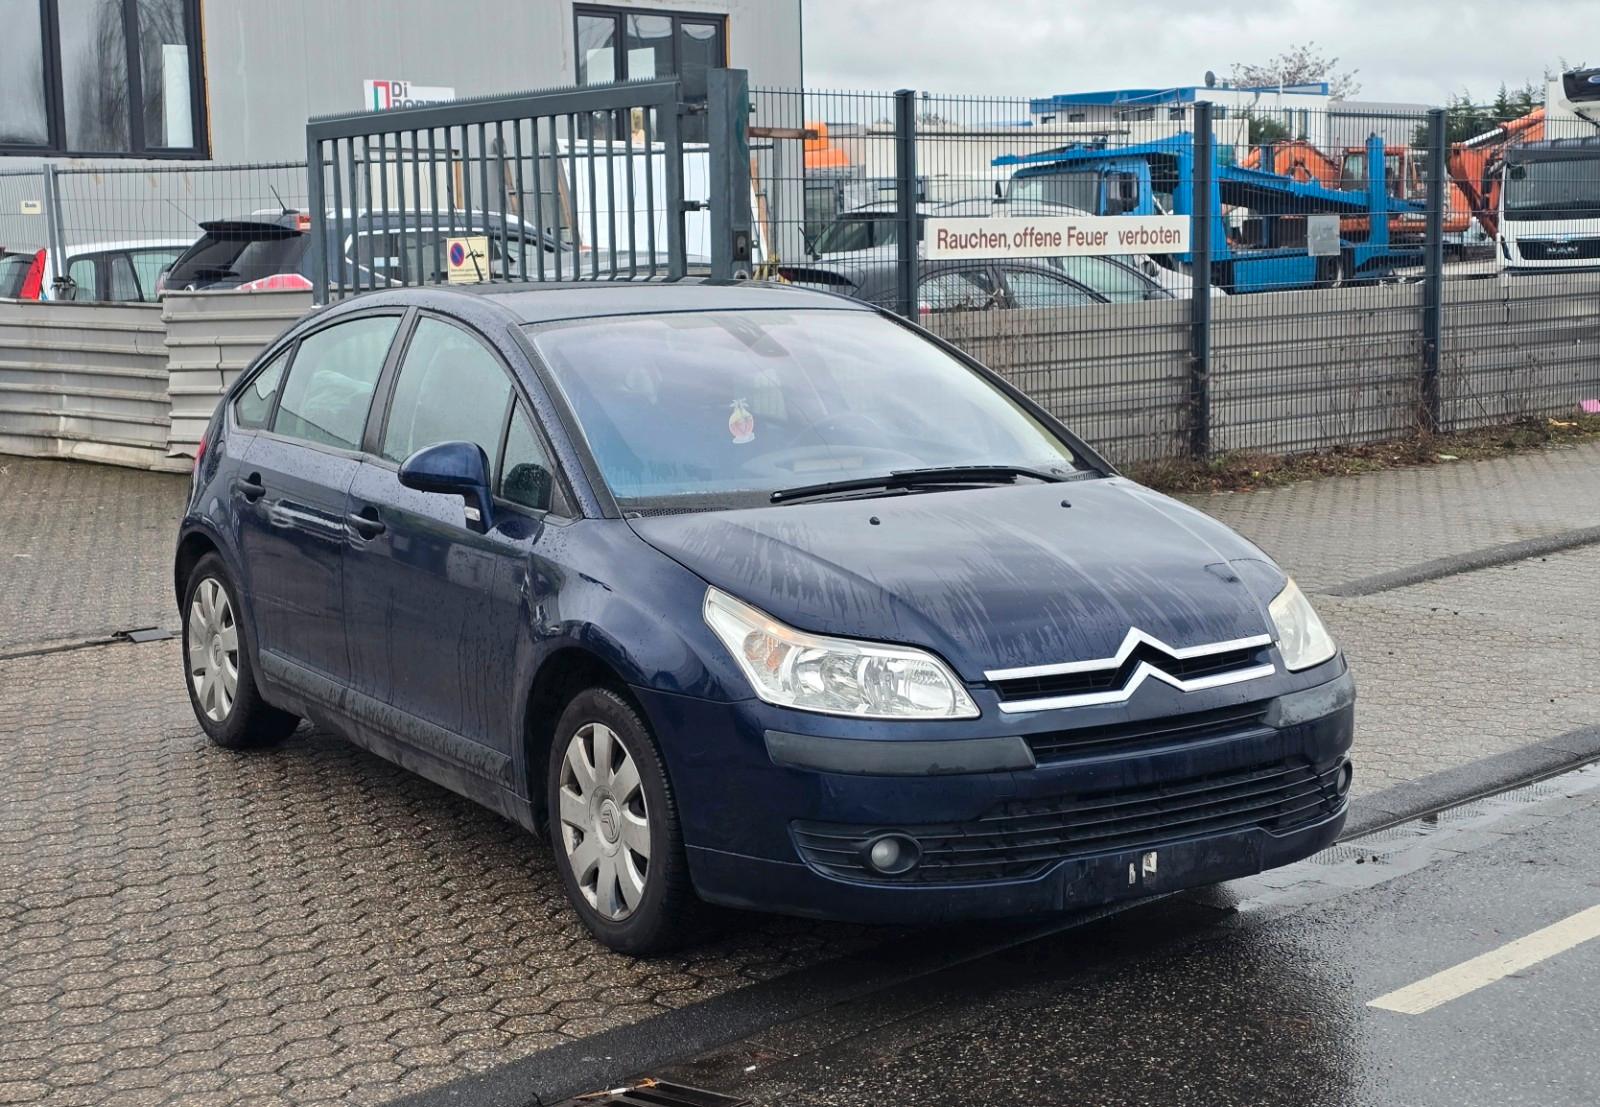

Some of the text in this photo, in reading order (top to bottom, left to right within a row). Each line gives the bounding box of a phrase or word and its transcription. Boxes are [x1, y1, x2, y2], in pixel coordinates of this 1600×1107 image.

[391, 82, 408, 98] Di
[937, 225, 1181, 250] Rauchen, offene Feuer verboten
